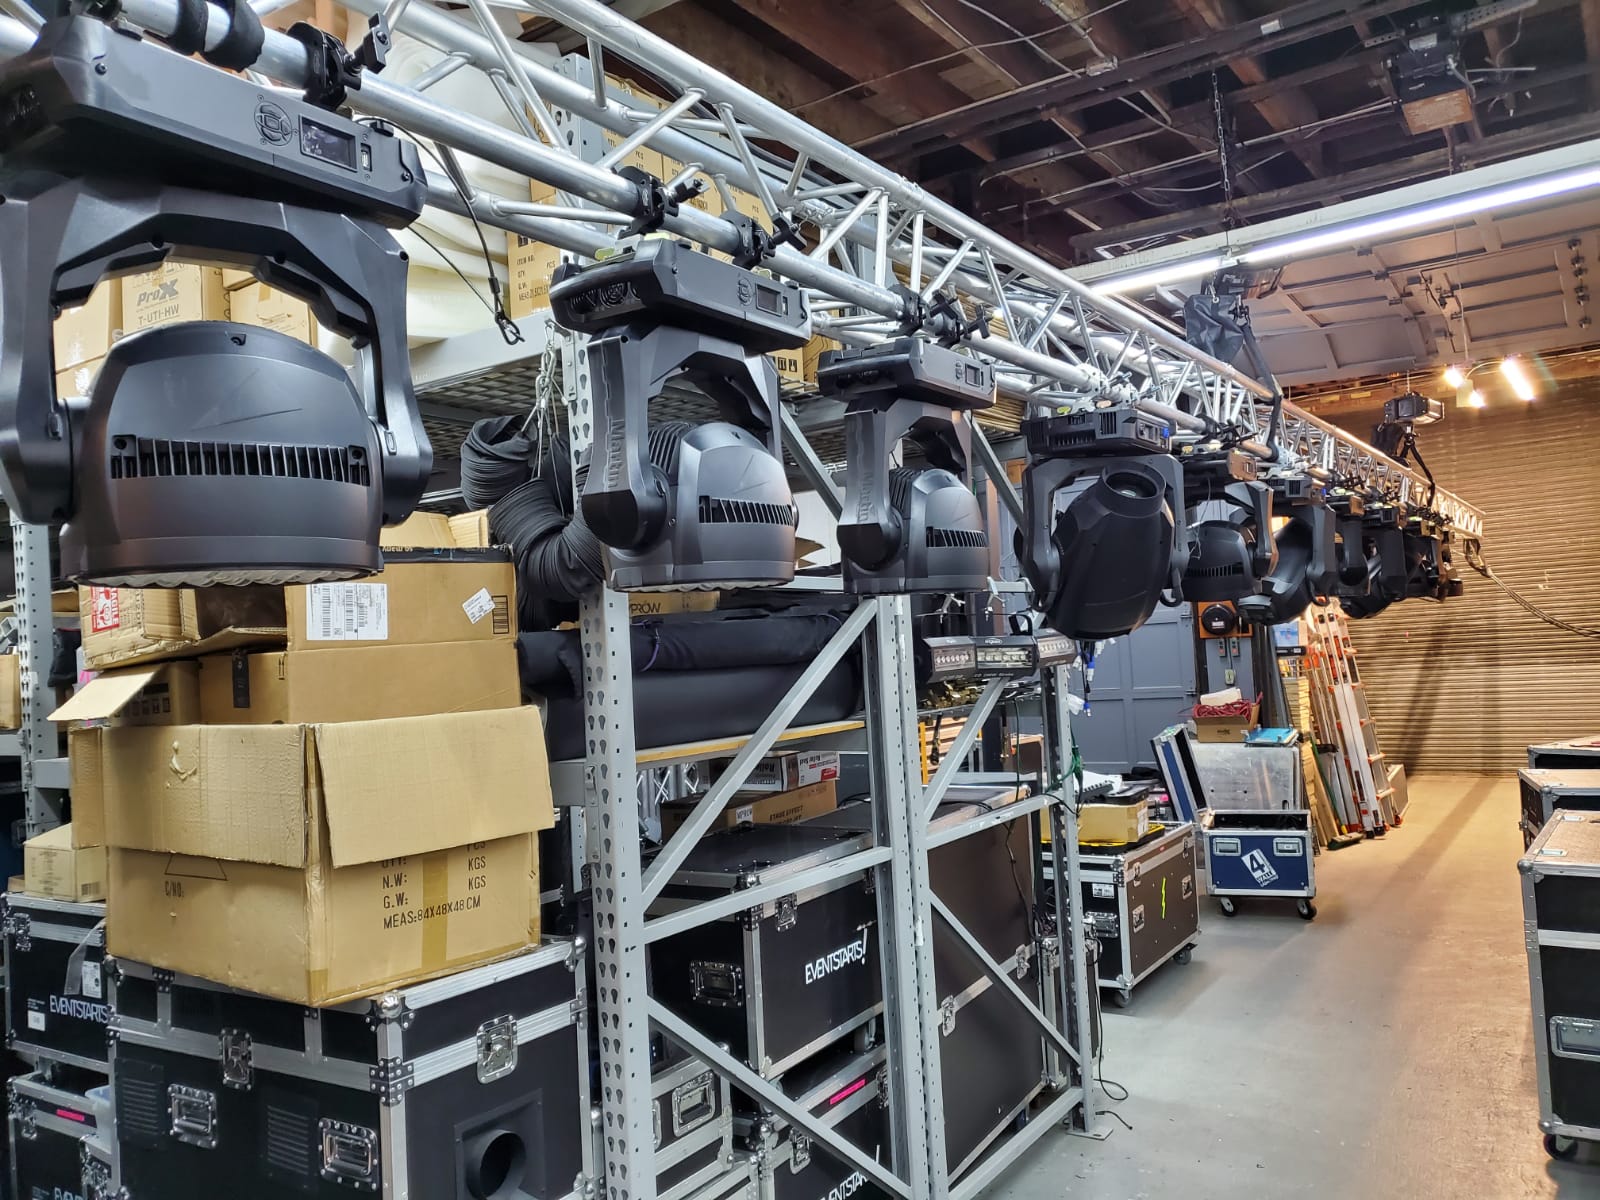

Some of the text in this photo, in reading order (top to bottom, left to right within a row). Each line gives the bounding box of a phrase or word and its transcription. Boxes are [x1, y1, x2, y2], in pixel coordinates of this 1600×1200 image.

[382, 856, 486, 889] N.W: KGS
[1248, 853, 1266, 874] 4
[383, 875, 487, 909] G.W: KGS
[466, 895, 481, 910] CM
[805, 928, 868, 985] EVENTSTARTS!
